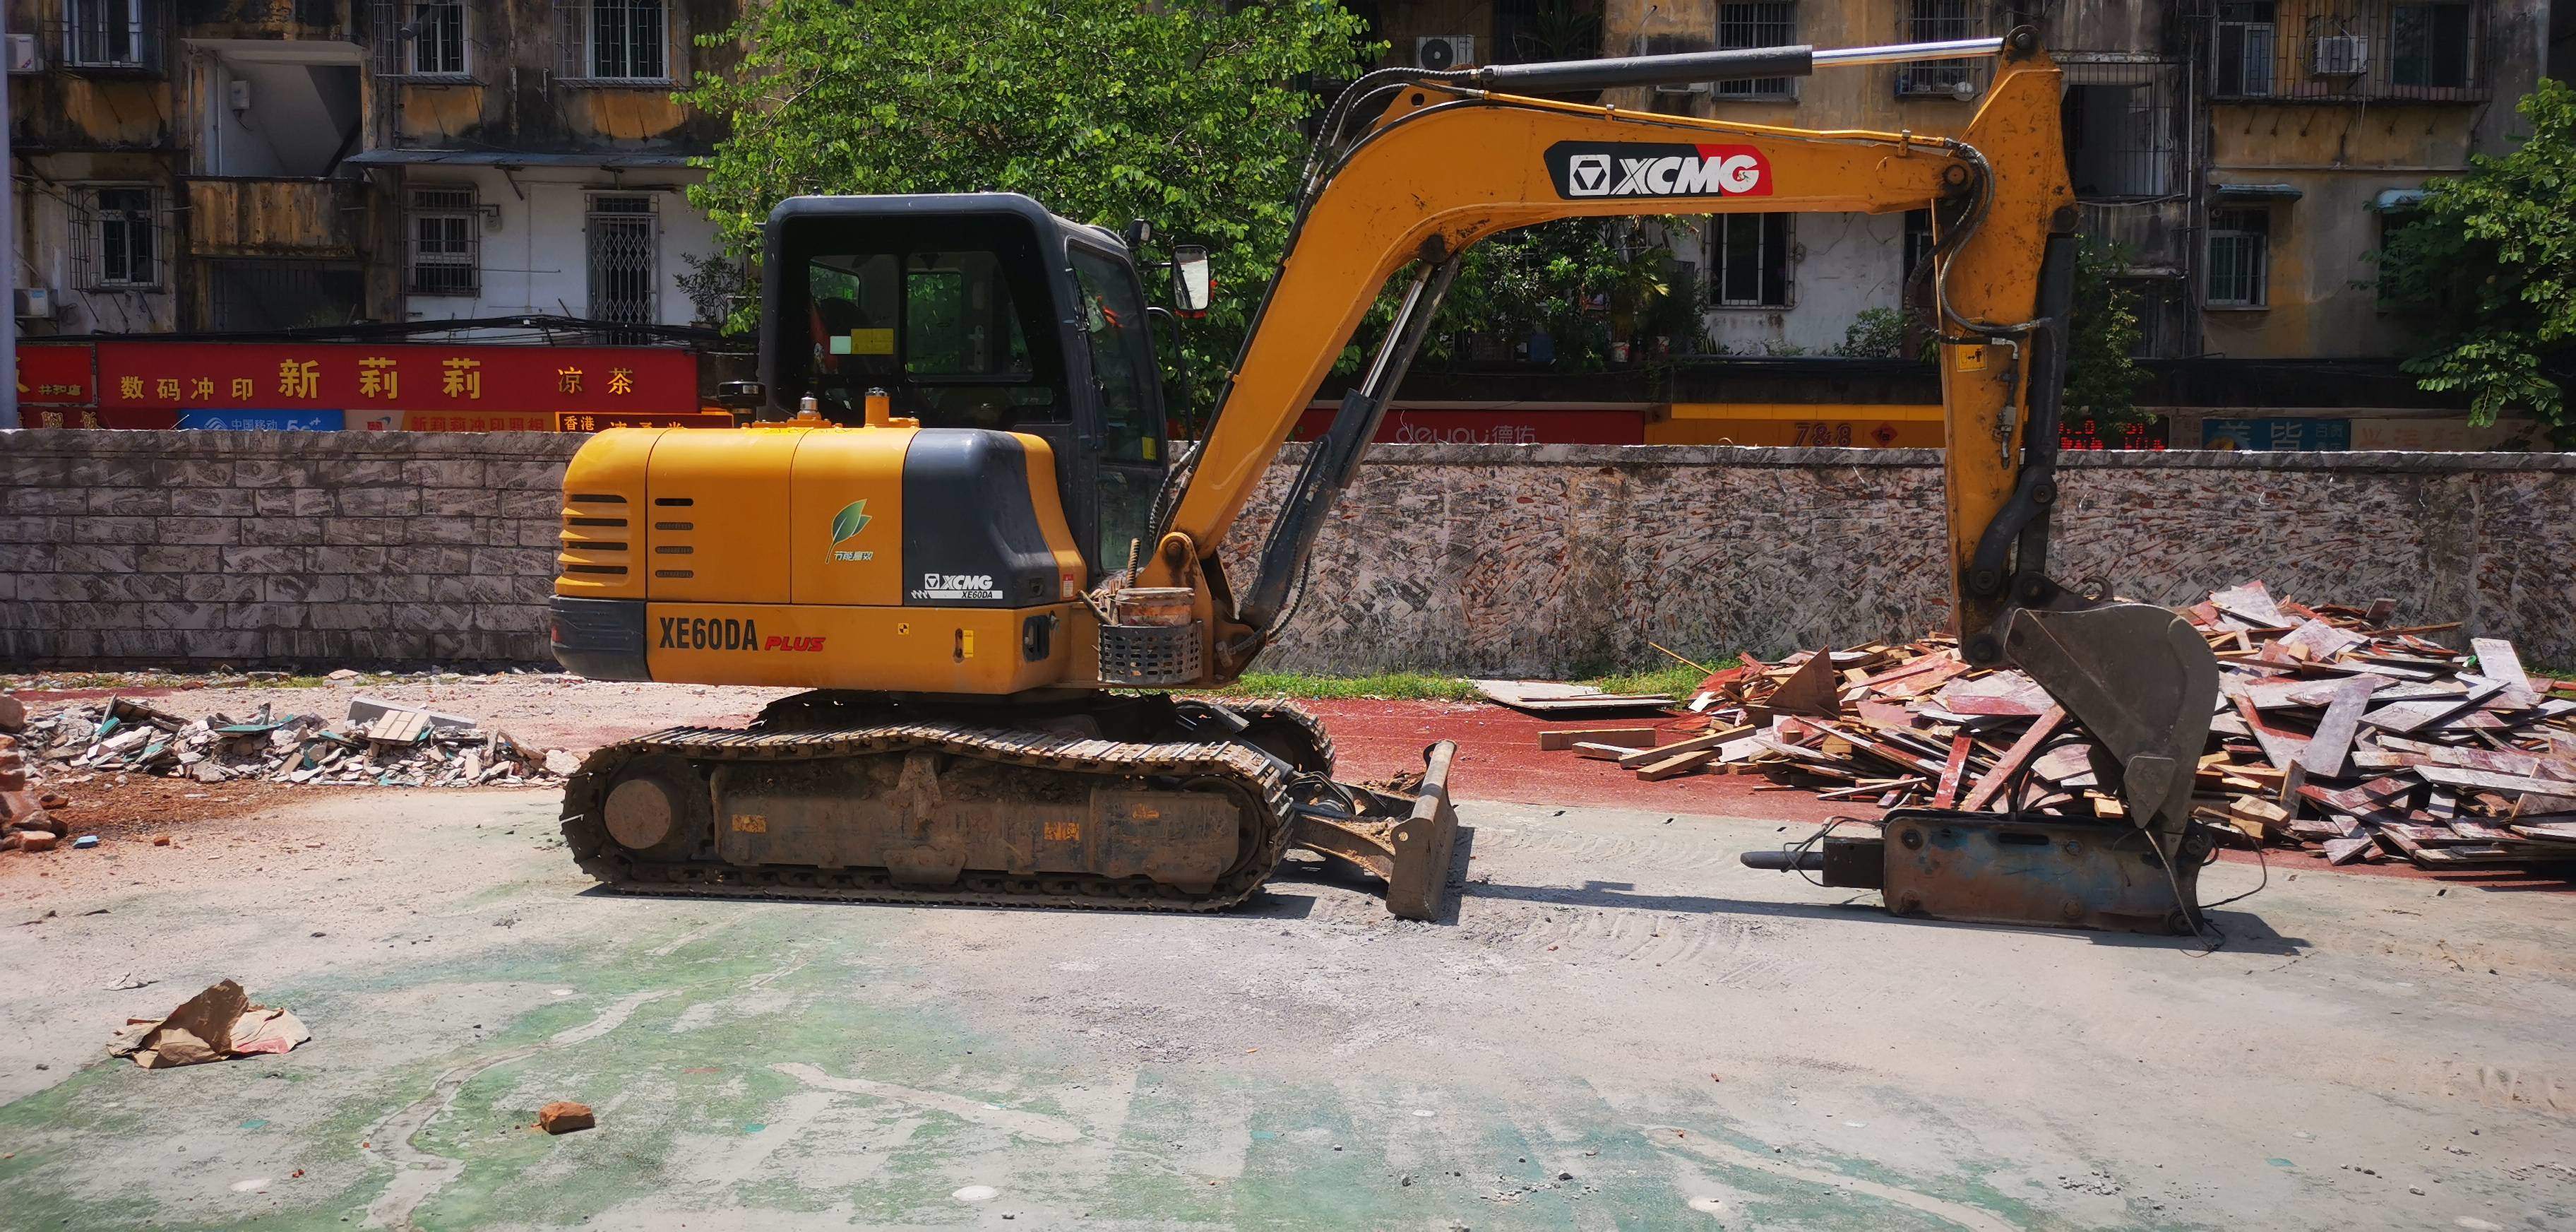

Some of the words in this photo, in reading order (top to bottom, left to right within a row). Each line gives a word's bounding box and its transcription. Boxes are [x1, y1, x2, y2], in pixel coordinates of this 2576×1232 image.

[1609, 154, 1760, 194] XCMG
[120, 375, 254, 401] 数码冲印
[278, 357, 482, 400] 新莉莉
[556, 366, 634, 395] 凉茶
[564, 415, 595, 430] 香港
[1491, 425, 1535, 444] 德佑
[940, 574, 993, 590] XCMG
[660, 617, 758, 651] XE60DA
[764, 636, 826, 652] PLUS
